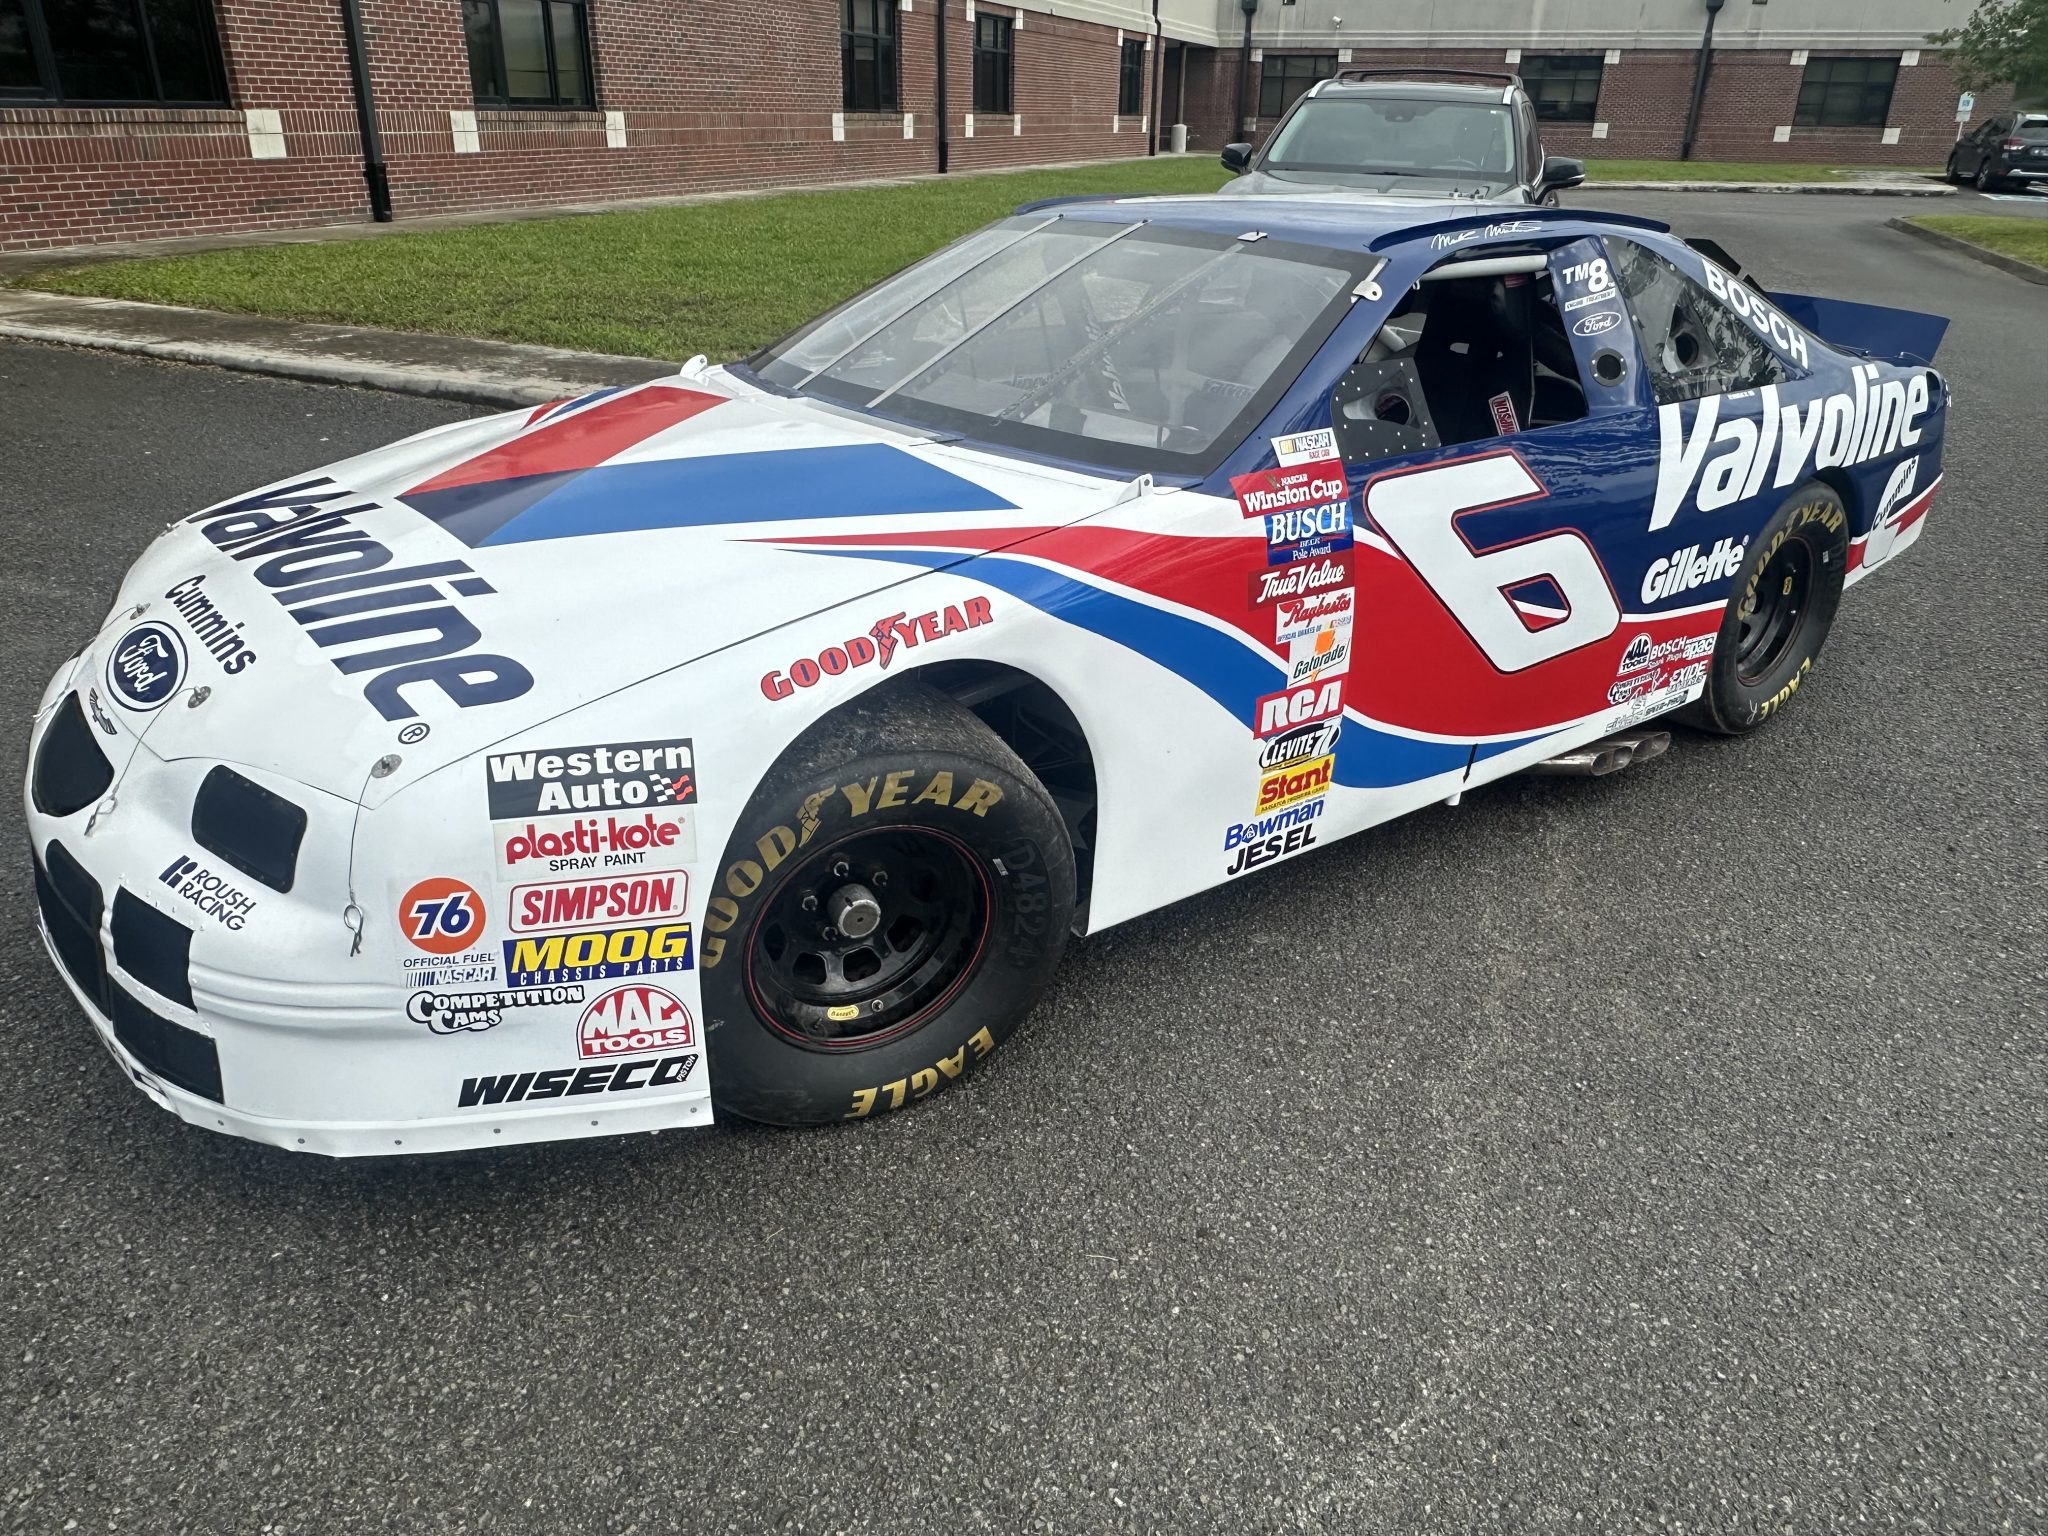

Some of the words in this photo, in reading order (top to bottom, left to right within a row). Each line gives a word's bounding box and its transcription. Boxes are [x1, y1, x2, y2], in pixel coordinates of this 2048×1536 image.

[1563, 258, 1609, 293] TM8
[1584, 315, 1613, 334] Ford
[1703, 259, 1809, 369] BOSCH
[1295, 432, 1331, 452] NASCAR
[1648, 364, 1930, 532] Valvoline
[1243, 485, 1311, 513] Winston
[1310, 478, 1343, 500] Cup
[1281, 473, 1309, 487] NASCAR
[1873, 457, 1917, 531] Cummins
[1270, 501, 1348, 545] BUSCH
[1292, 548, 1308, 561] Pole
[1309, 542, 1331, 558] Award
[1367, 454, 1621, 673] 6
[1641, 537, 1745, 604] Gillette
[186, 476, 536, 722] Valvoline
[164, 574, 258, 675] Cummins
[118, 634, 169, 693] Ford
[1293, 643, 1346, 679] Gatorade
[1622, 656, 1648, 671] TOOLS
[1623, 638, 1649, 663] MAC
[1650, 636, 1687, 660] BOSCH
[1682, 638, 1713, 660] apac
[1669, 660, 1709, 685] EXIDE
[1261, 679, 1342, 733] RCA
[490, 746, 692, 783] Western
[1259, 758, 1331, 806] Stant
[537, 777, 649, 811] Auto
[507, 813, 681, 865] plasti-kote
[1224, 799, 1324, 850] Bowman
[549, 855, 598, 872] SPRAY
[604, 851, 646, 867] PAINT
[1227, 824, 1317, 876] JESEL
[177, 881, 246, 931] RACING
[191, 868, 257, 916] ROUSH
[521, 877, 675, 926] SIMPSON
[409, 890, 475, 941] 76
[403, 955, 459, 968] OFFICIAL
[462, 952, 495, 964] FUEL
[511, 925, 691, 974] MOOG
[434, 966, 496, 987] NASCAR
[520, 964, 607, 986] CHASSIS
[623, 956, 683, 975] PARTS
[408, 985, 585, 1022] COMPETITION
[431, 1010, 501, 1034] CAMS
[583, 989, 687, 1038] MAC
[584, 1027, 687, 1053] TOOLS
[457, 1053, 699, 1108] WISECO
[677, 1055, 696, 1083] PISTON
[844, 1025, 996, 1118] EAGLE
